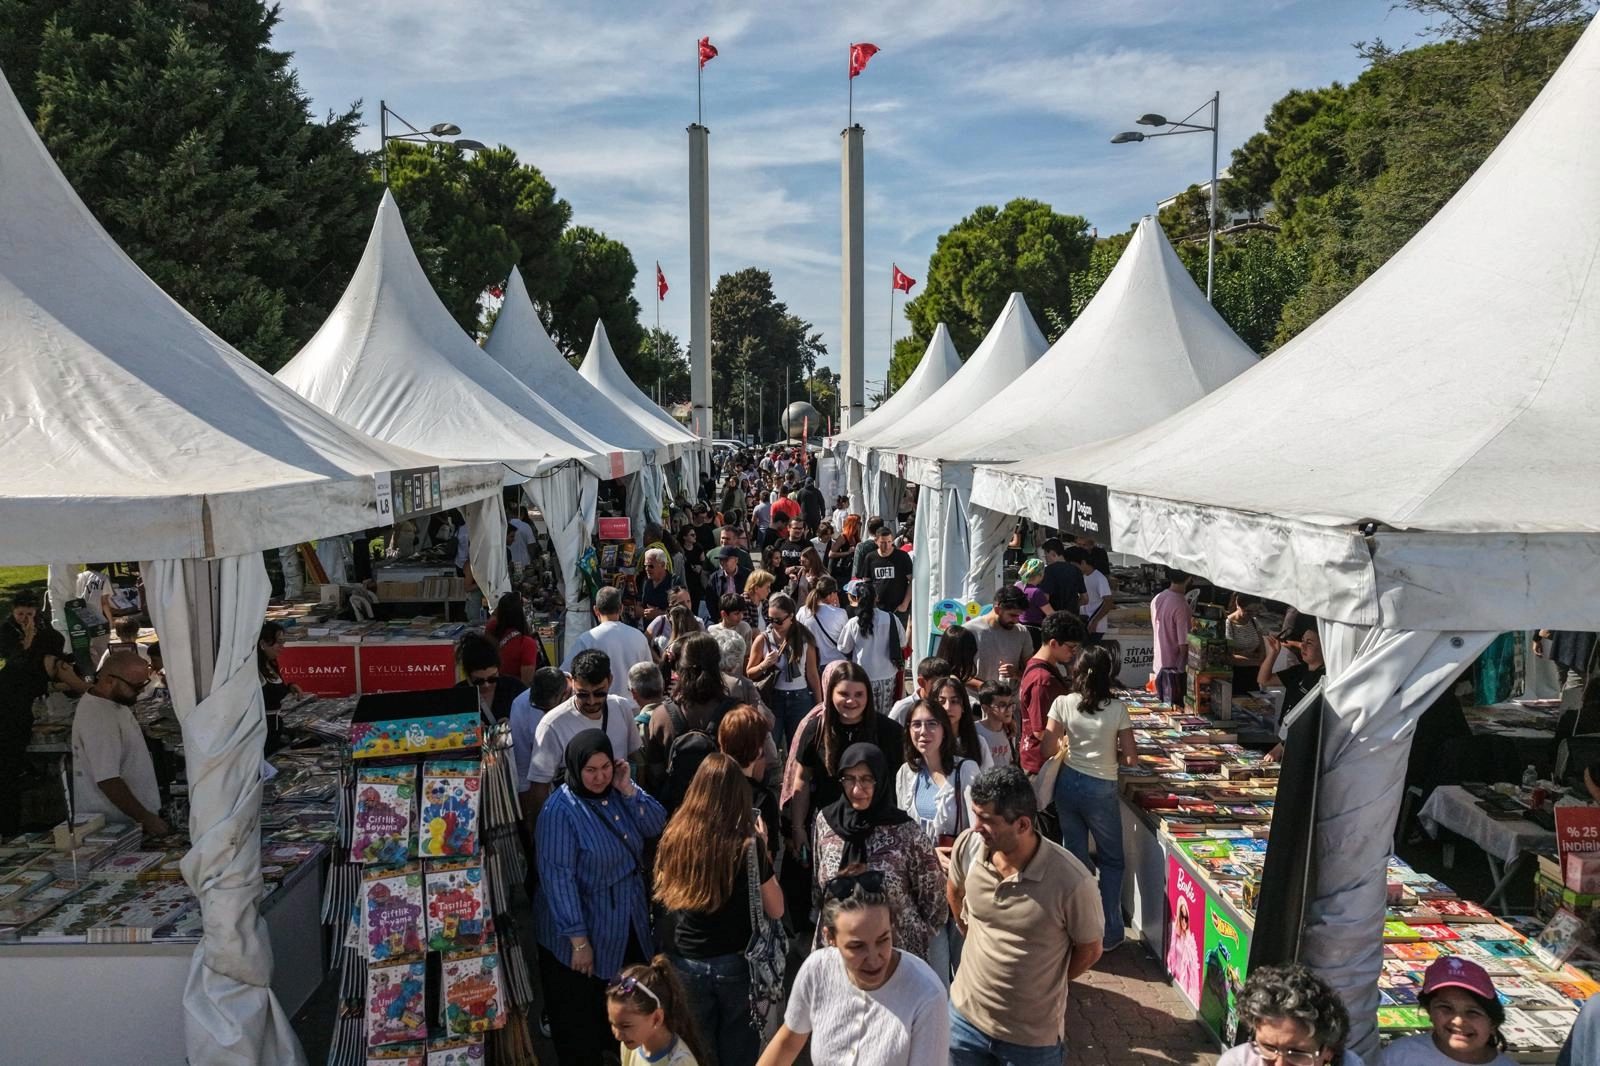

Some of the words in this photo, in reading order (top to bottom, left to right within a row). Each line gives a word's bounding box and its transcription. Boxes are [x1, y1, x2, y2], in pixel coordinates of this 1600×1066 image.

[380, 498, 390, 515] L8
[876, 568, 893, 578] LOFT
[307, 666, 347, 674] SANAT
[407, 664, 447, 672] SANAT
[1567, 826, 1580, 838] %
[1582, 826, 1598, 838] 25
[1177, 867, 1196, 903] Barbie
